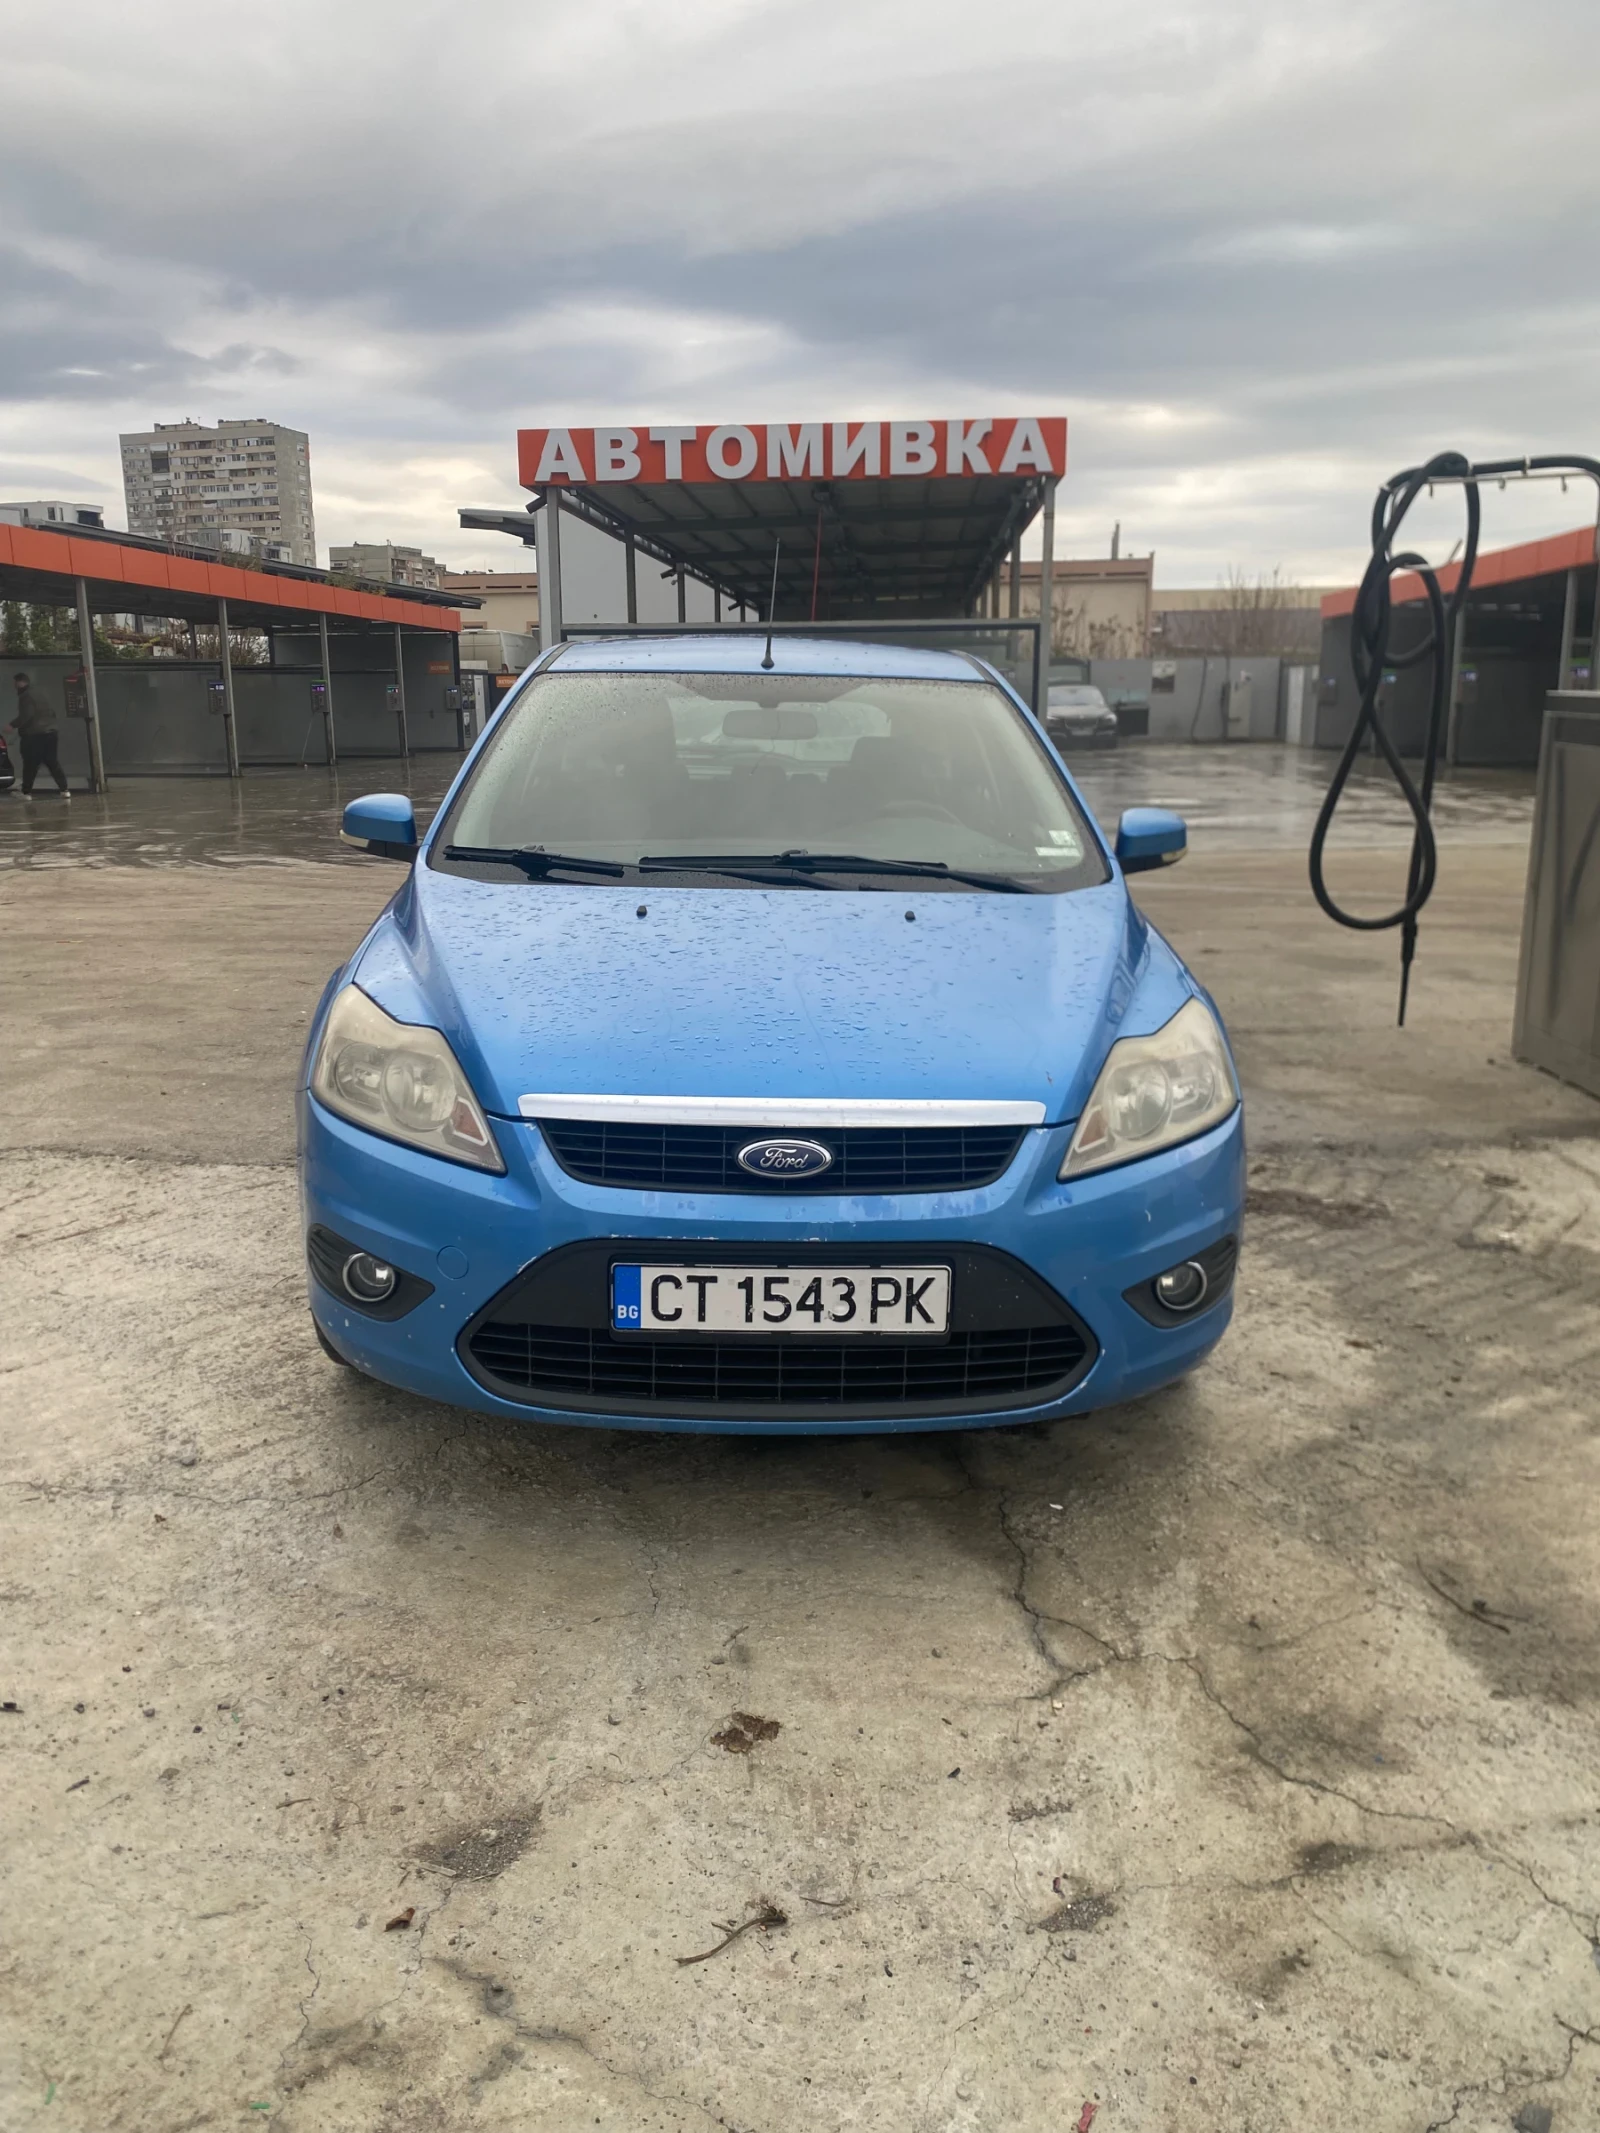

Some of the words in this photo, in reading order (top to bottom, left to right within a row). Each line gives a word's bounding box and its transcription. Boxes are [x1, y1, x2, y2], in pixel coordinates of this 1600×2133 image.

[534, 418, 1053, 482] АВТОМИВКА
[760, 1147, 809, 1169] Ford
[617, 1305, 639, 1319] BG
[650, 1274, 718, 1323] CT
[737, 1275, 857, 1323] 1543
[870, 1276, 936, 1324] PK
